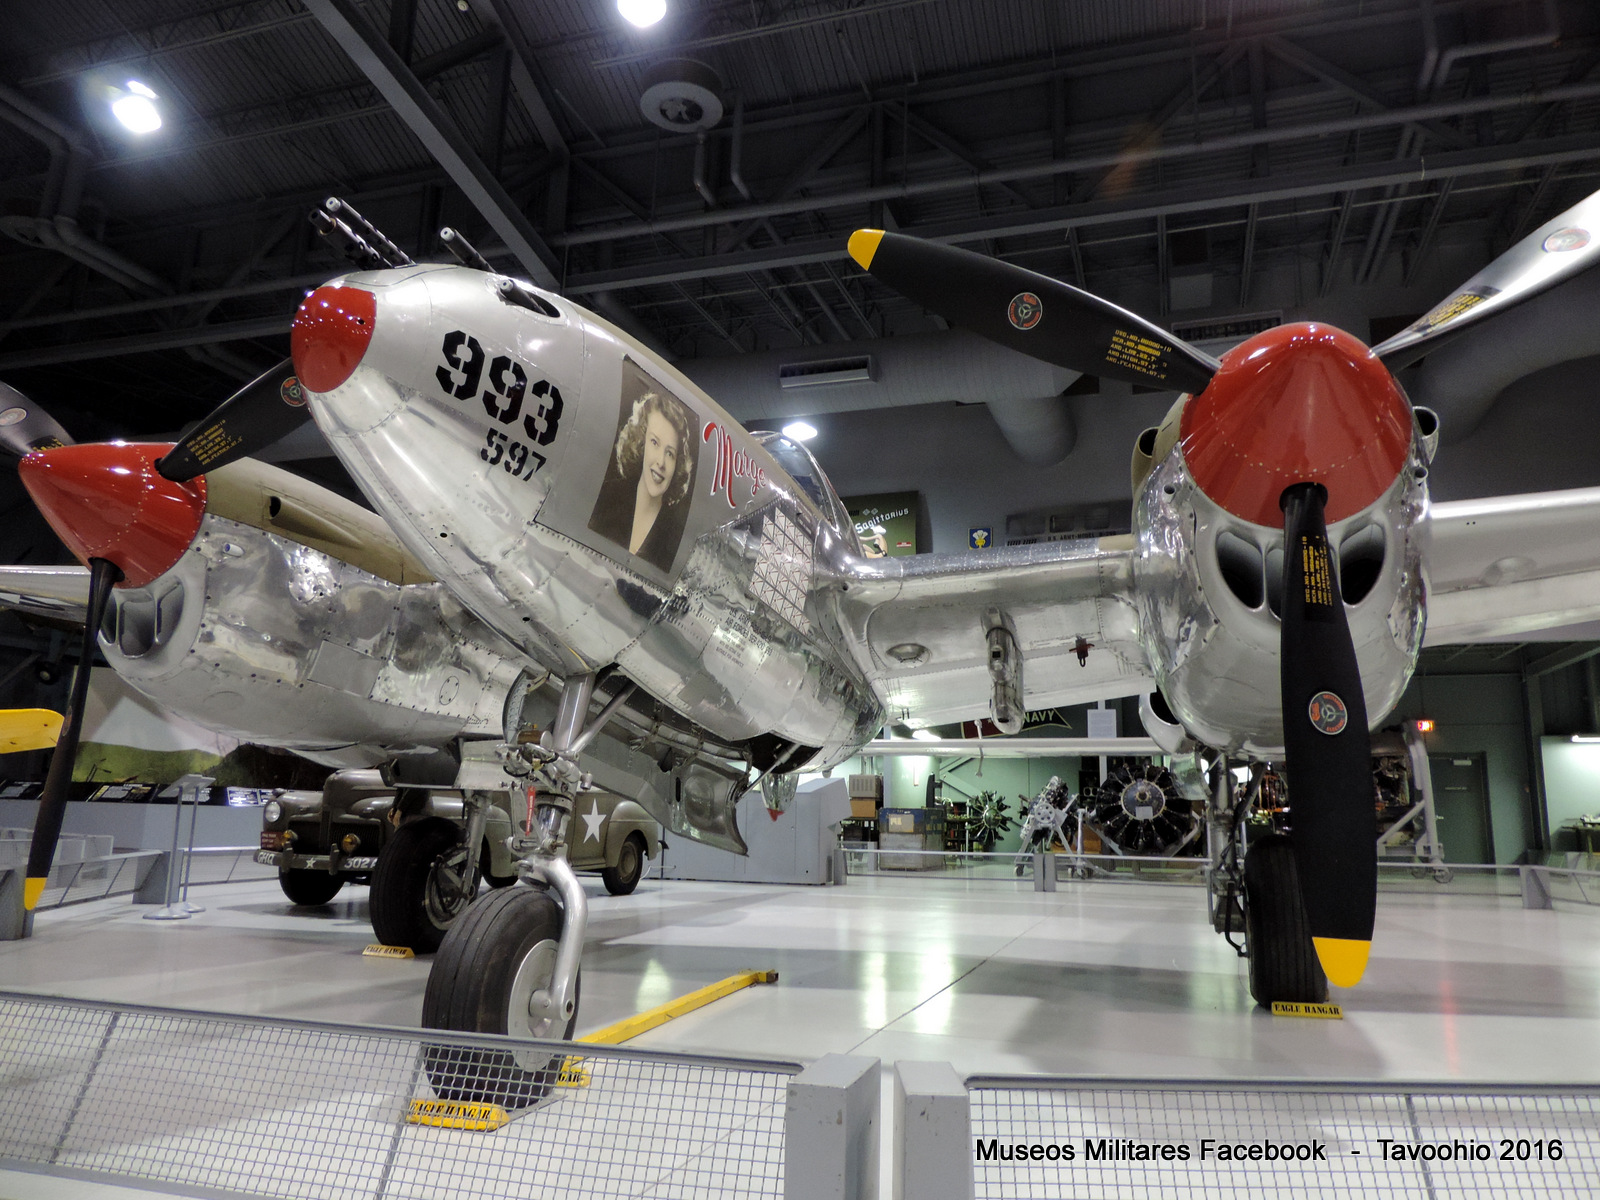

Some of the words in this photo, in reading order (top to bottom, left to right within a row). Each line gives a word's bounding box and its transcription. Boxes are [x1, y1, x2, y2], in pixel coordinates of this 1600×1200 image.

[435, 330, 564, 446] 993
[480, 427, 547, 482] 597
[702, 421, 766, 509] Marge
[1022, 710, 1054, 723] NAVY
[1275, 1003, 1301, 1013] EAGLE
[1304, 1005, 1340, 1015] HANGAR
[445, 1104, 491, 1120] HANGAR
